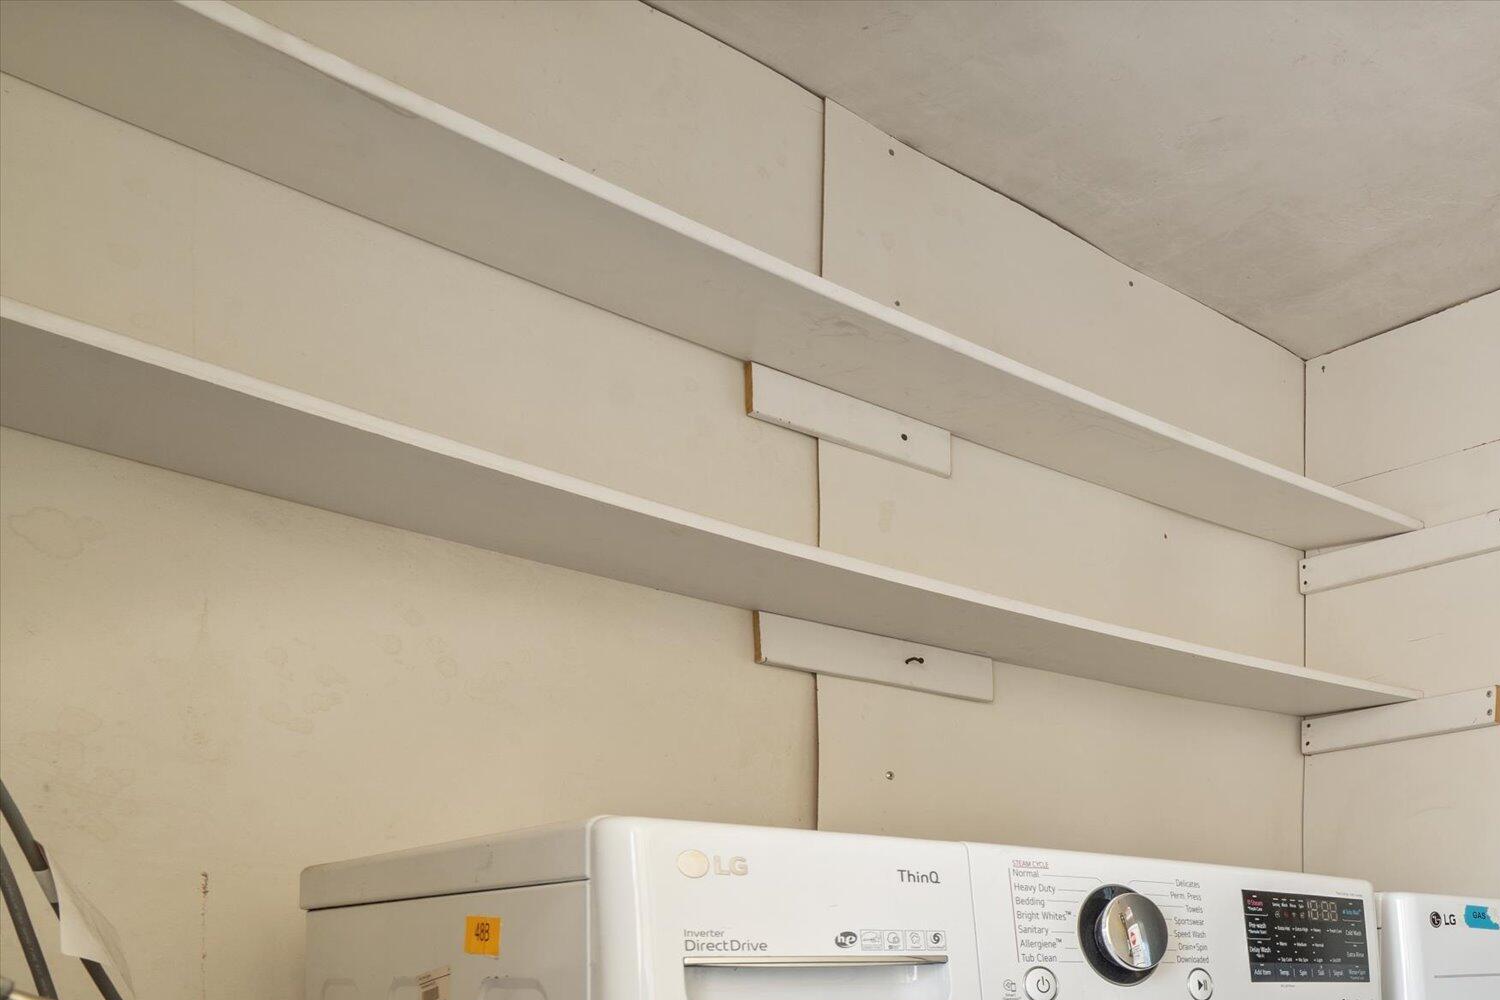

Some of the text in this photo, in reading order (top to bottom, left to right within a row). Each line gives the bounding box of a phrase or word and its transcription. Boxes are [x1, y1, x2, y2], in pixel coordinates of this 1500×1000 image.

[713, 855, 749, 876] LG
[897, 869, 941, 884] ThinQ
[1013, 869, 1040, 878] Normal
[1014, 883, 1056, 893] Heavy Duty
[1175, 879, 1200, 888] Delicates
[1187, 893, 1201, 901] Press
[1016, 897, 1045, 908] Bedding
[1185, 905, 1204, 913] Towels
[1017, 911, 1039, 920] Bright
[1444, 914, 1457, 926] LG
[1472, 911, 1486, 920] GAS
[1174, 917, 1205, 926] Sportswear
[683, 929, 725, 938] Inverter
[1018, 925, 1049, 935] Sanitary
[1022, 954, 1057, 962] Tub Clean
[1177, 956, 1209, 964] Downloaded
